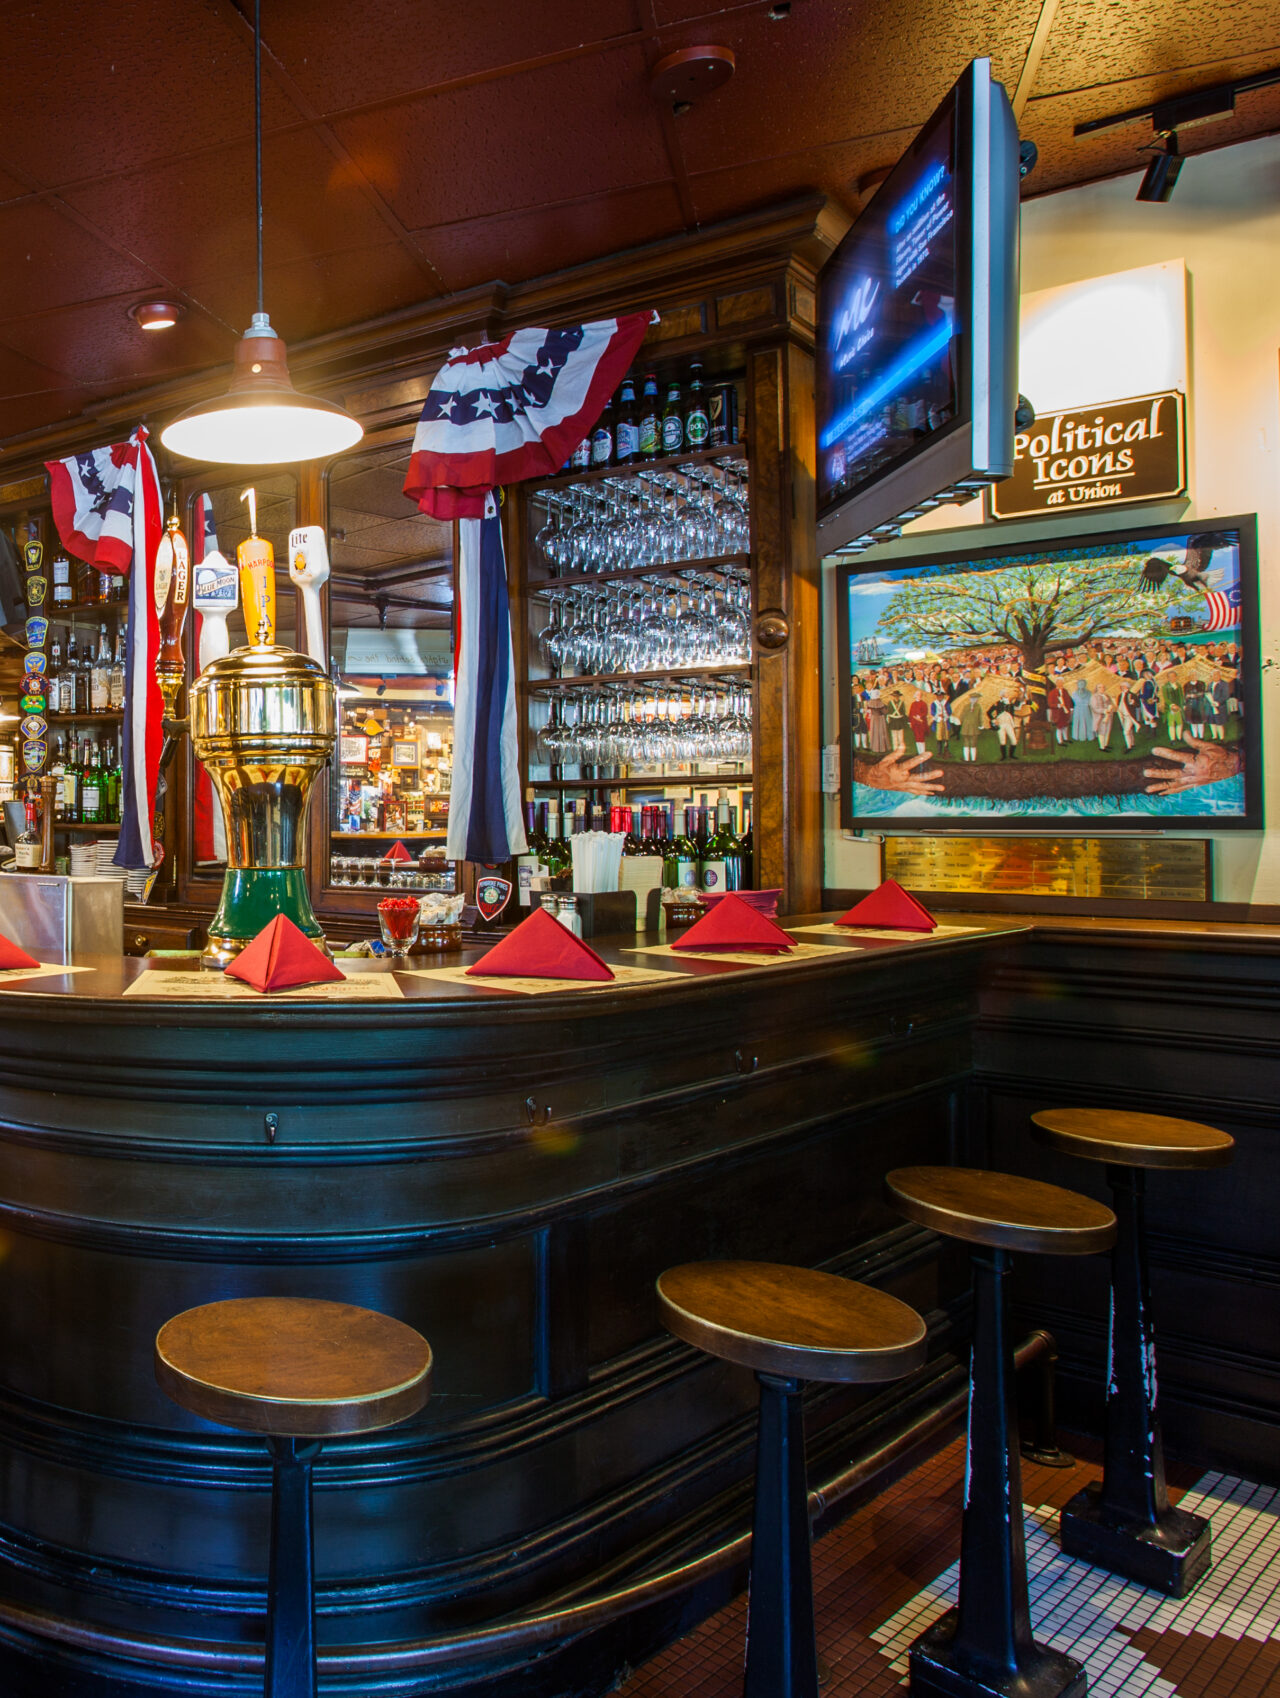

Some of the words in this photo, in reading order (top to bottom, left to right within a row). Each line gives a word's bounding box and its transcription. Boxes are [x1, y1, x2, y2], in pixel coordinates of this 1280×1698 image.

[1014, 398, 1164, 461] Political
[1033, 448, 1135, 484] Icons
[1047, 489, 1066, 505] at
[1069, 481, 1122, 502] Union
[291, 533, 308, 548] Lite
[176, 551, 186, 601] LAGER
[217, 576, 235, 587] MOON
